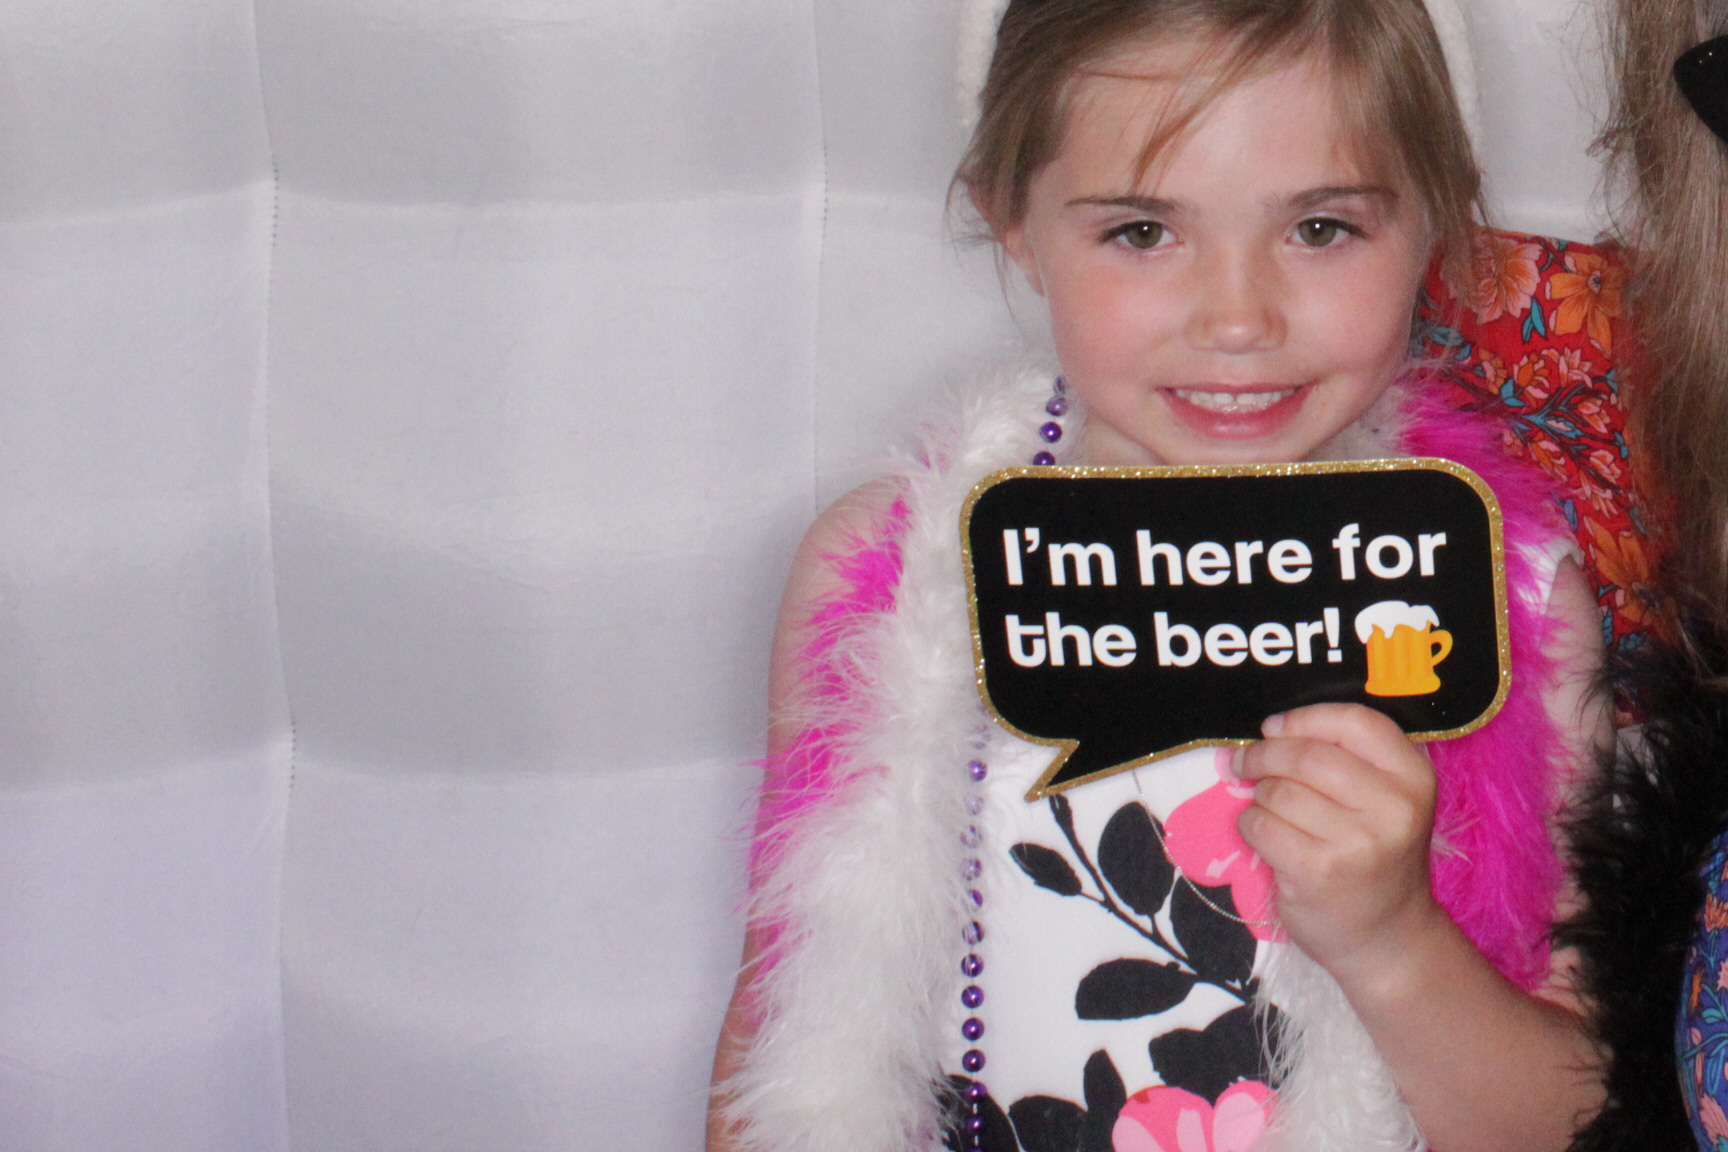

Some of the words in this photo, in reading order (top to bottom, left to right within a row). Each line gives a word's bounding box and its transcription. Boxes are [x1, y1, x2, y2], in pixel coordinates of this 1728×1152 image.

[1003, 527, 1117, 586] I'm
[1136, 529, 1313, 586] here
[1333, 523, 1447, 580] for
[1005, 611, 1137, 667] the
[1153, 607, 1342, 666] beer!
